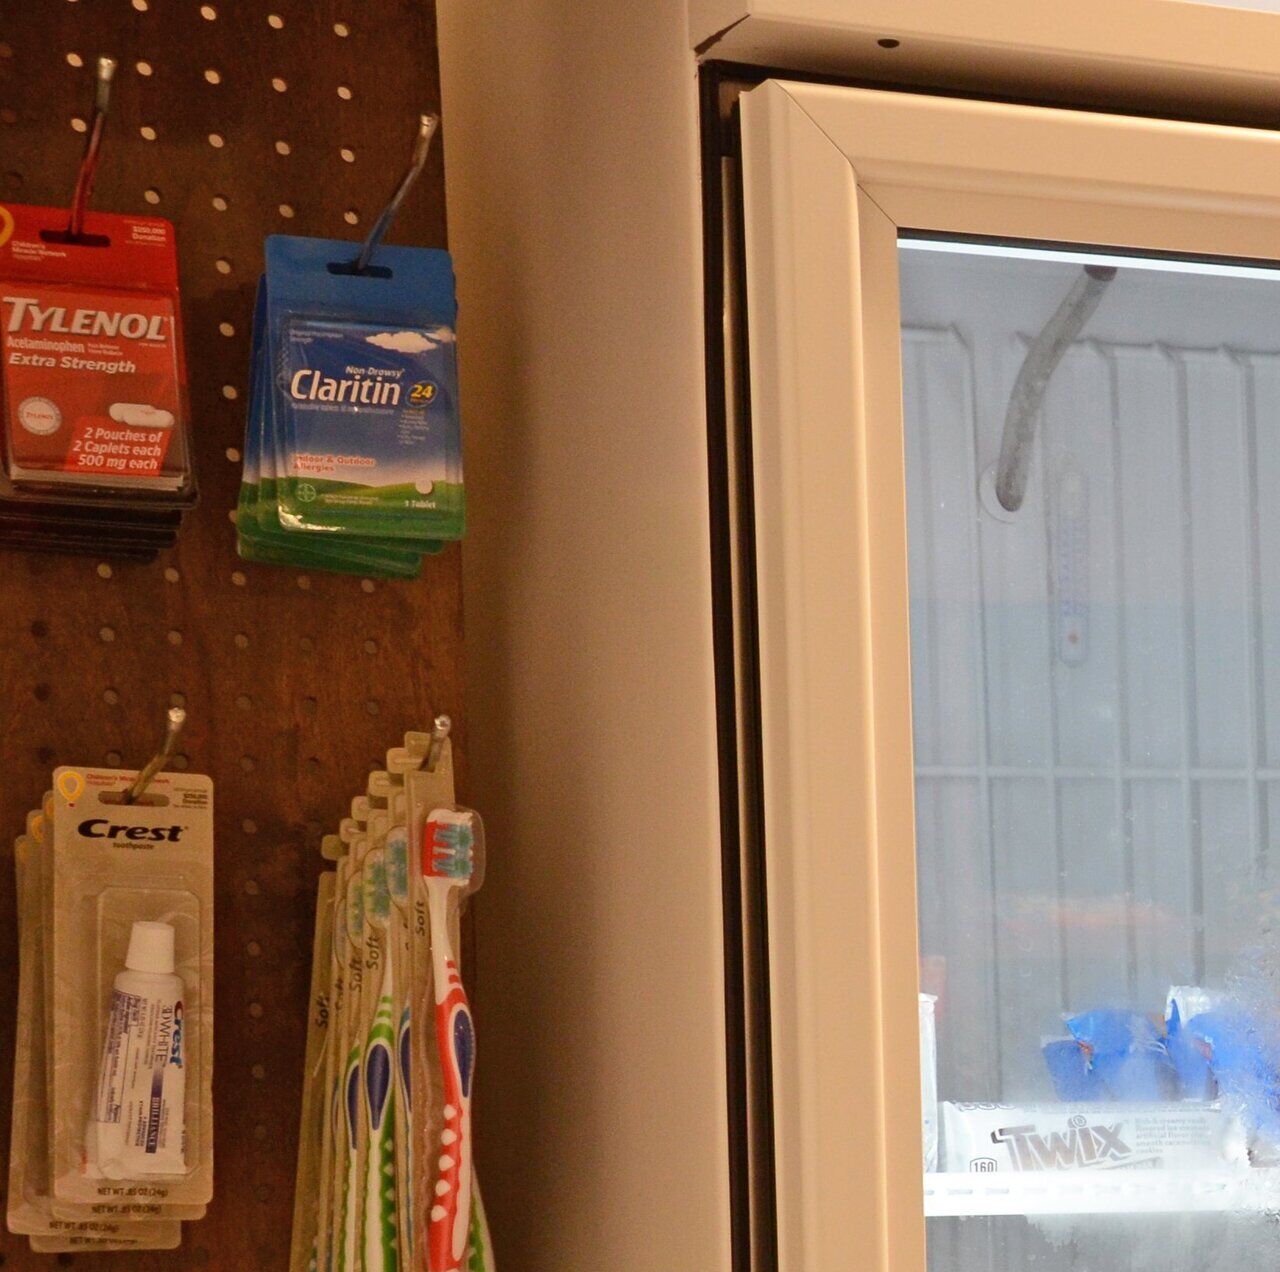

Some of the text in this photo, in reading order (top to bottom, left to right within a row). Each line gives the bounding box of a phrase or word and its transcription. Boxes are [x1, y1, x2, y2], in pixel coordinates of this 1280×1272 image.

[3, 296, 166, 341] TYLENOL
[7, 336, 85, 353] Acetaminophen
[9, 352, 136, 374] Extra Strength
[290, 369, 400, 406] Claritin
[410, 384, 433, 399] 24
[84, 427, 163, 443] 2 Pouches of
[73, 440, 161, 457] 2 Caplets each
[78, 454, 157, 470] 500 mg each
[77, 819, 183, 842] Crest
[113, 842, 155, 850] toothpaste
[416, 900, 425, 936] Soft
[367, 935, 380, 970] Soft
[350, 959, 362, 992] Soft
[170, 1001, 183, 1066] Crest
[98, 1187, 110, 1196] NET
